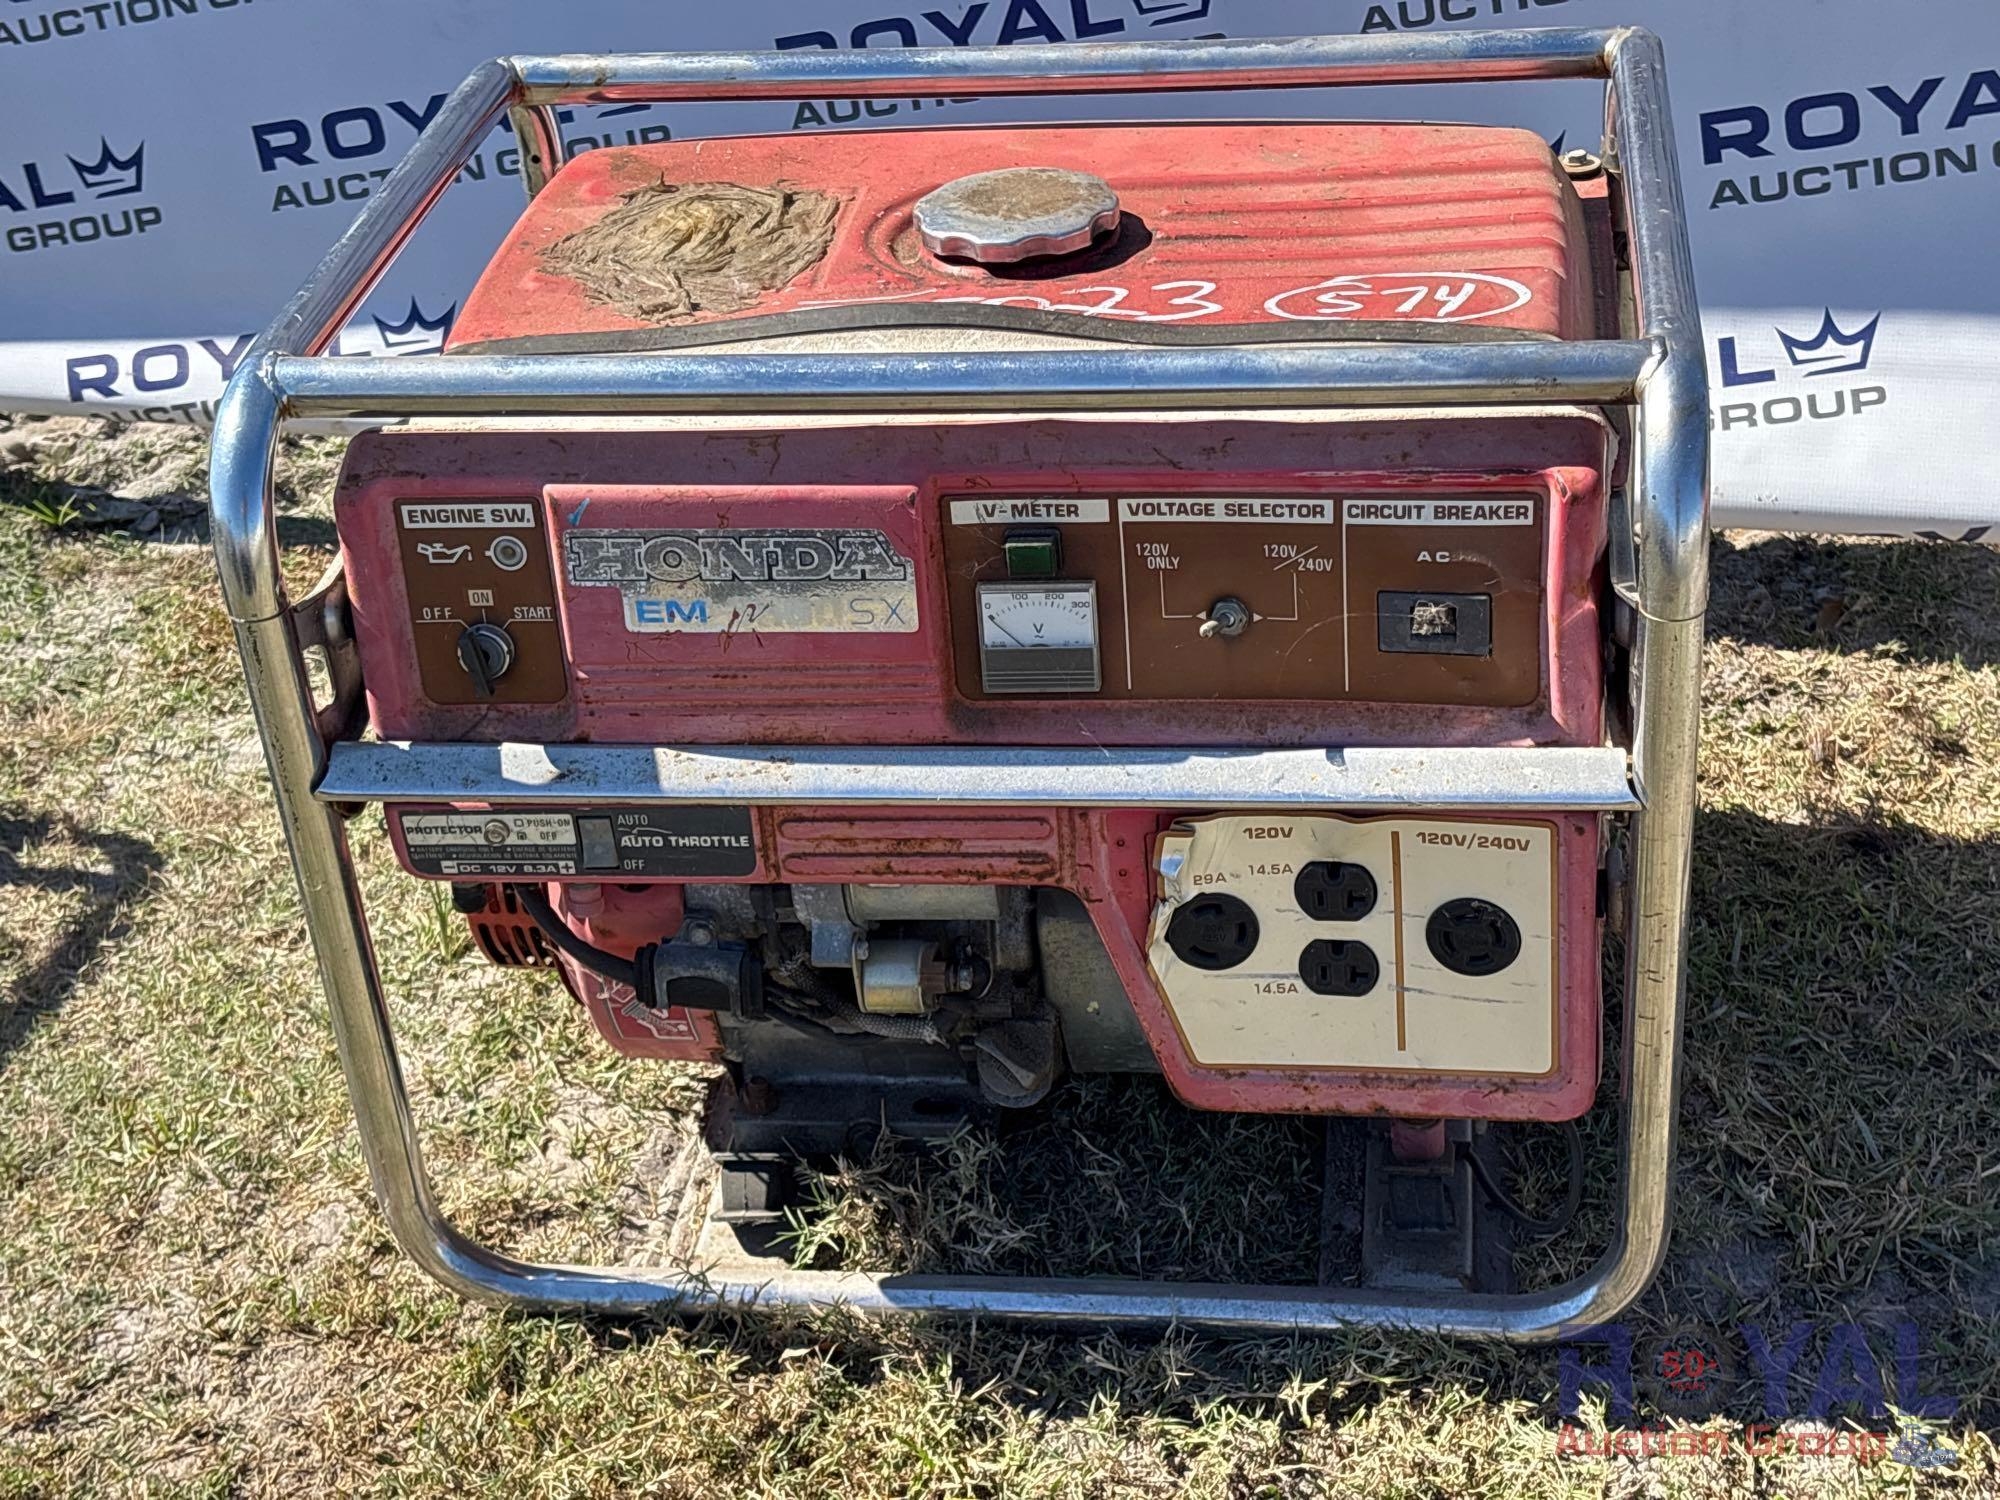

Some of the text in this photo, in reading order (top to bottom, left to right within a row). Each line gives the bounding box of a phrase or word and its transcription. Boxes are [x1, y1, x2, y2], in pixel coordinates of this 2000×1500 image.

[252, 93, 574, 172] ROY
[1709, 143, 1978, 209] AUCTION
[7, 206, 162, 252] GROUP
[1709, 385, 1887, 432] ROUP
[407, 508, 531, 524] ENGINE SW.
[1127, 502, 1326, 518] VOLTAGE SELECTOR
[1347, 504, 1530, 520] CIRCUIT BREAKER
[1136, 543, 1169, 556] 120V
[568, 536, 907, 582] HONDA
[1147, 556, 1180, 570] ONLY
[1416, 551, 1451, 563] AC
[472, 591, 490, 604] ON
[1011, 593, 1065, 601] 100 200
[984, 602, 992, 610] 0
[1071, 601, 1091, 609] 300
[423, 607, 453, 620] OFF
[513, 606, 552, 619] START
[1032, 622, 1045, 634] V
[617, 814, 649, 826] AUTO
[406, 825, 483, 836] PROTECTOR
[1242, 826, 1294, 840] 120V
[620, 835, 751, 848] AUTO THROTTLE
[1415, 831, 1531, 852] 120V/240V
[459, 864, 481, 873] DC
[488, 864, 516, 873] 12V
[624, 858, 646, 871] OFF
[1248, 863, 1293, 876] 14.5A
[1193, 872, 1227, 886] 29A
[1254, 983, 1299, 995] 14.5A
